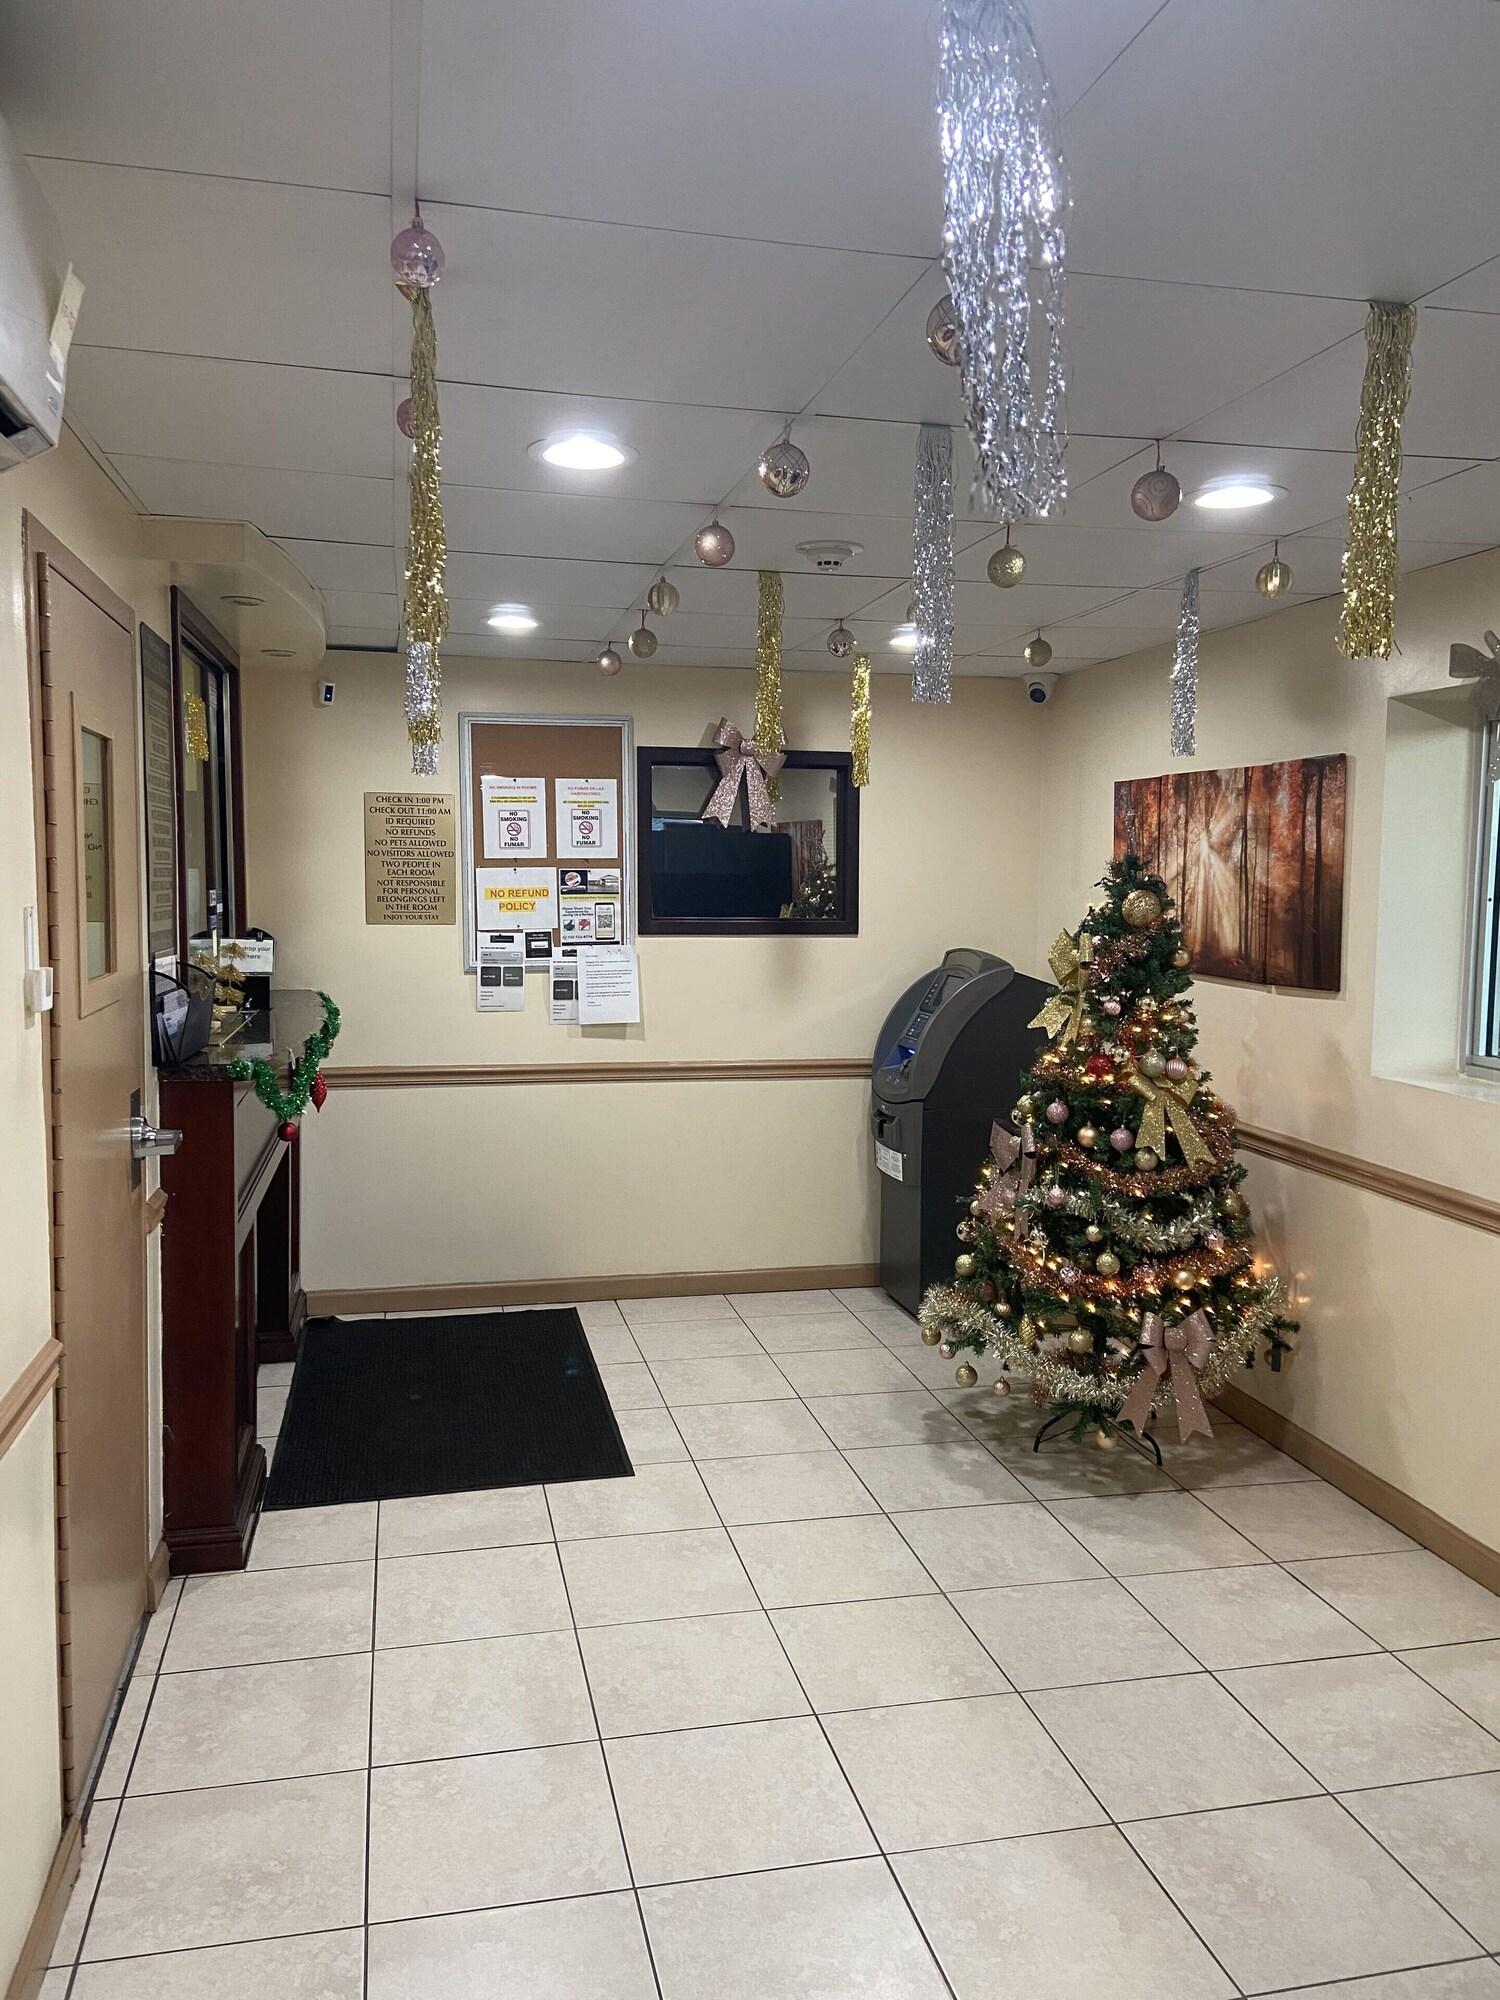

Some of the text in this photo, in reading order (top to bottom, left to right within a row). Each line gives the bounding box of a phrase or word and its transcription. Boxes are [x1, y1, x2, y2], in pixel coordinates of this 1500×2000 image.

[396, 818, 435, 826] REQUIRED
[417, 850, 454, 858] ALLOWED
[490, 889, 549, 898] NO REFUND
[499, 902, 536, 910] POLICY
